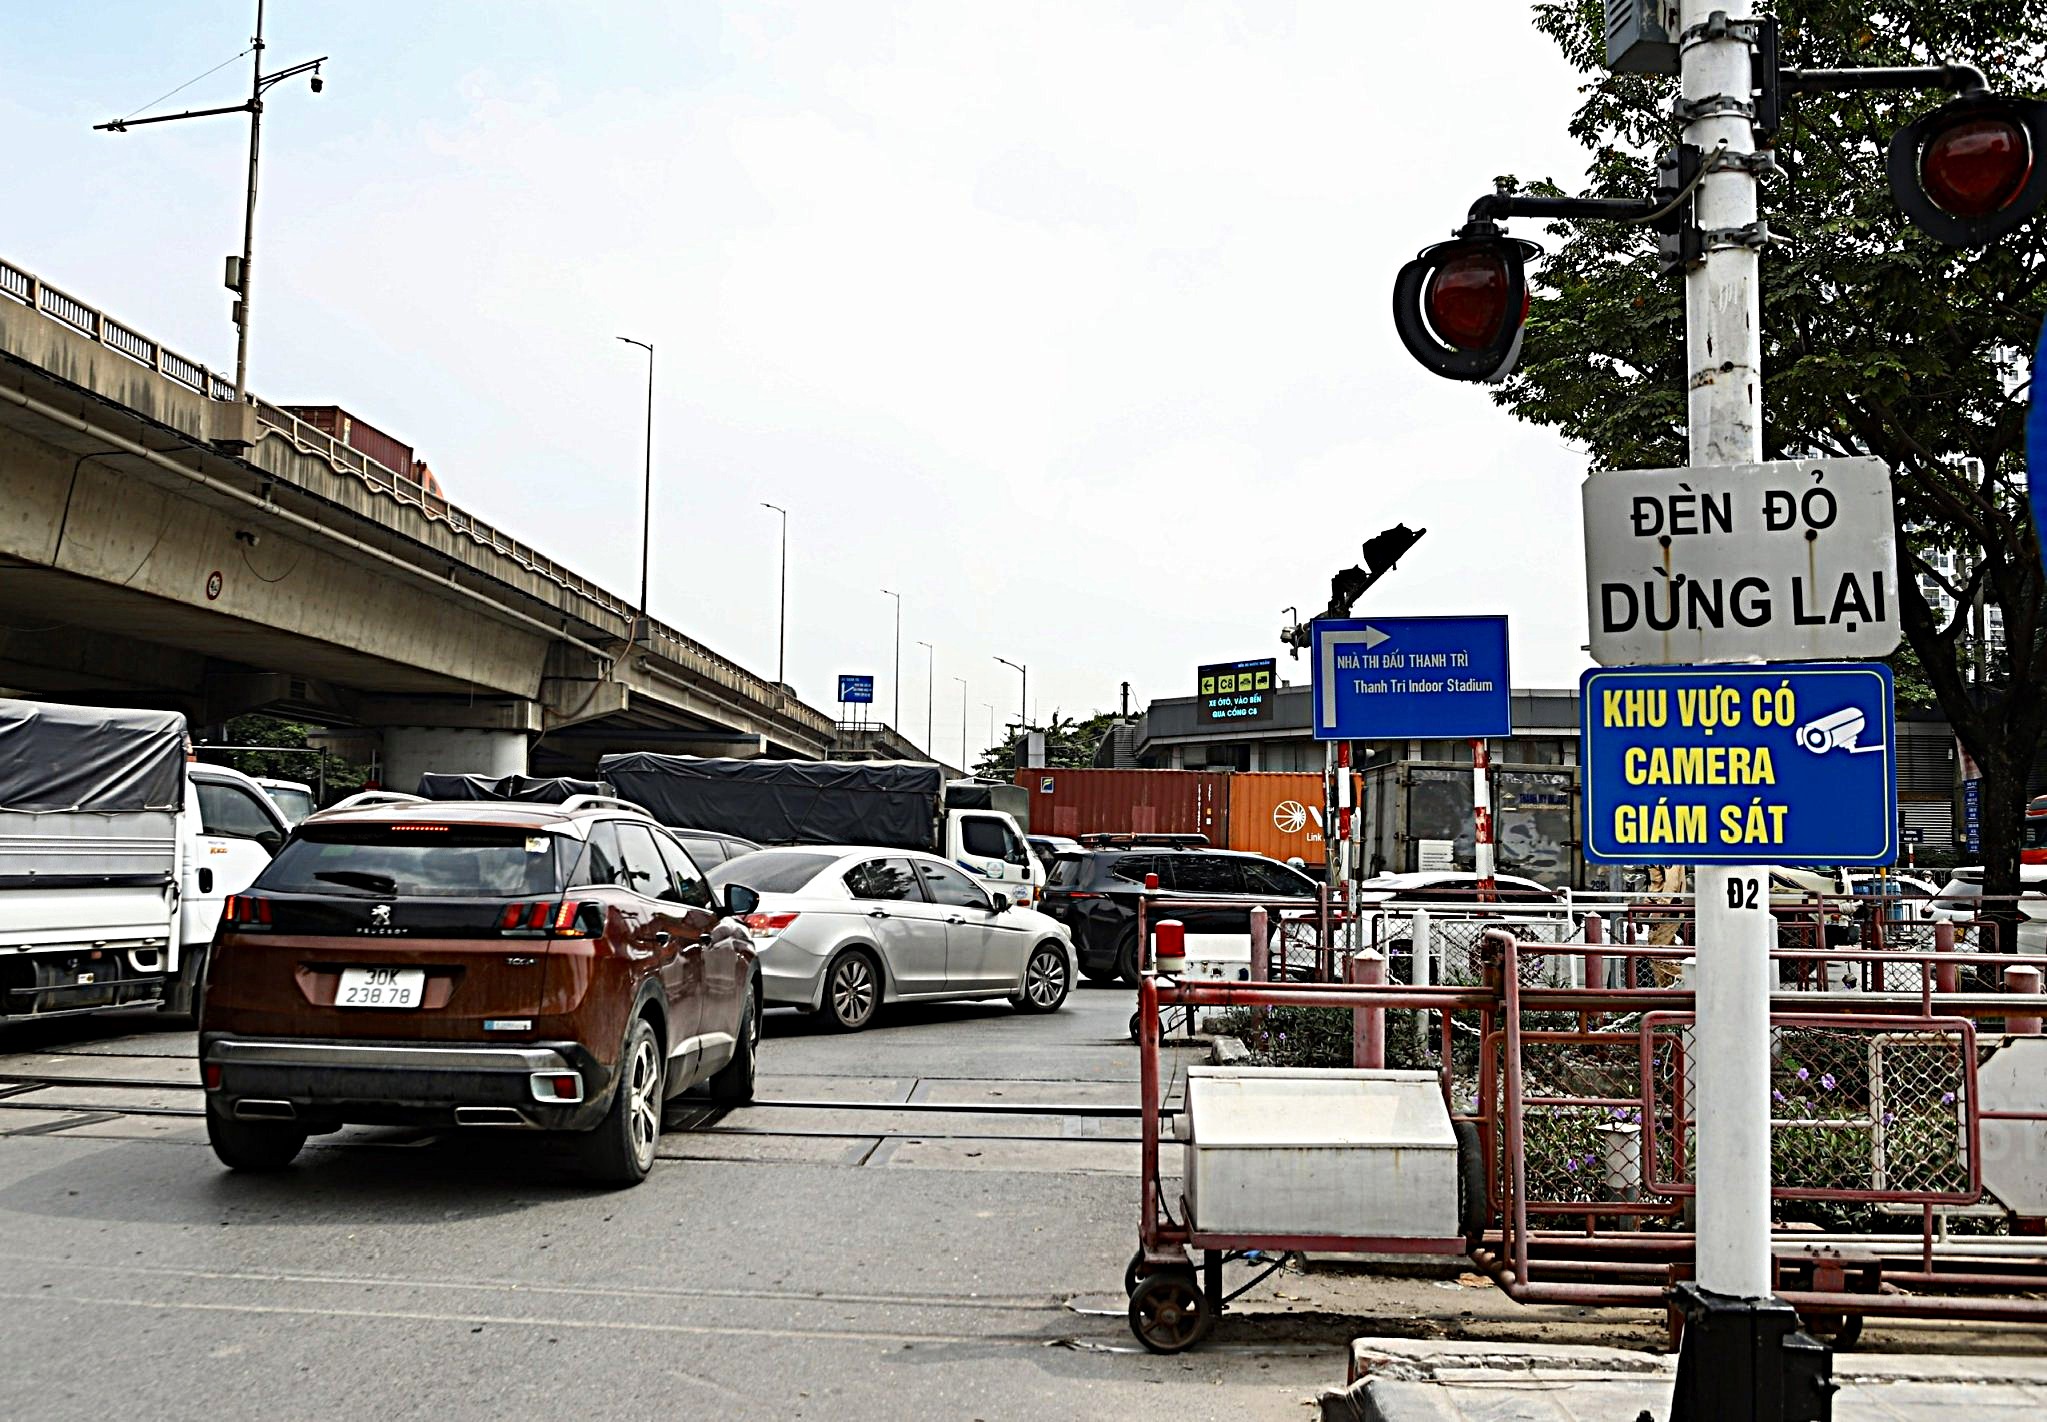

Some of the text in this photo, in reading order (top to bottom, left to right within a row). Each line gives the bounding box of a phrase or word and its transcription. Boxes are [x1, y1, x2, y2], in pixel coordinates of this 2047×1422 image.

[1630, 469, 1837, 537] ĐÈN ĐỎ
[1601, 566, 1886, 633] DỪNG LẠI
[1337, 648, 1468, 669] NHÀ THI ĐẤU THANH TRÌ
[1220, 678, 1233, 689] C8
[1354, 678, 1493, 694] Thanh Tri Indoor Stadium
[1212, 710, 1226, 718] QUA
[1603, 679, 1796, 736] KHU VỰC CÓ
[1624, 746, 1776, 785] CAMERA
[1614, 797, 1788, 844] GIÁM SÁT
[1306, 832, 1323, 842] Link
[1727, 877, 1760, 910] Đ2
[364, 968, 401, 986] 30K
[345, 987, 412, 1005] 238.78
